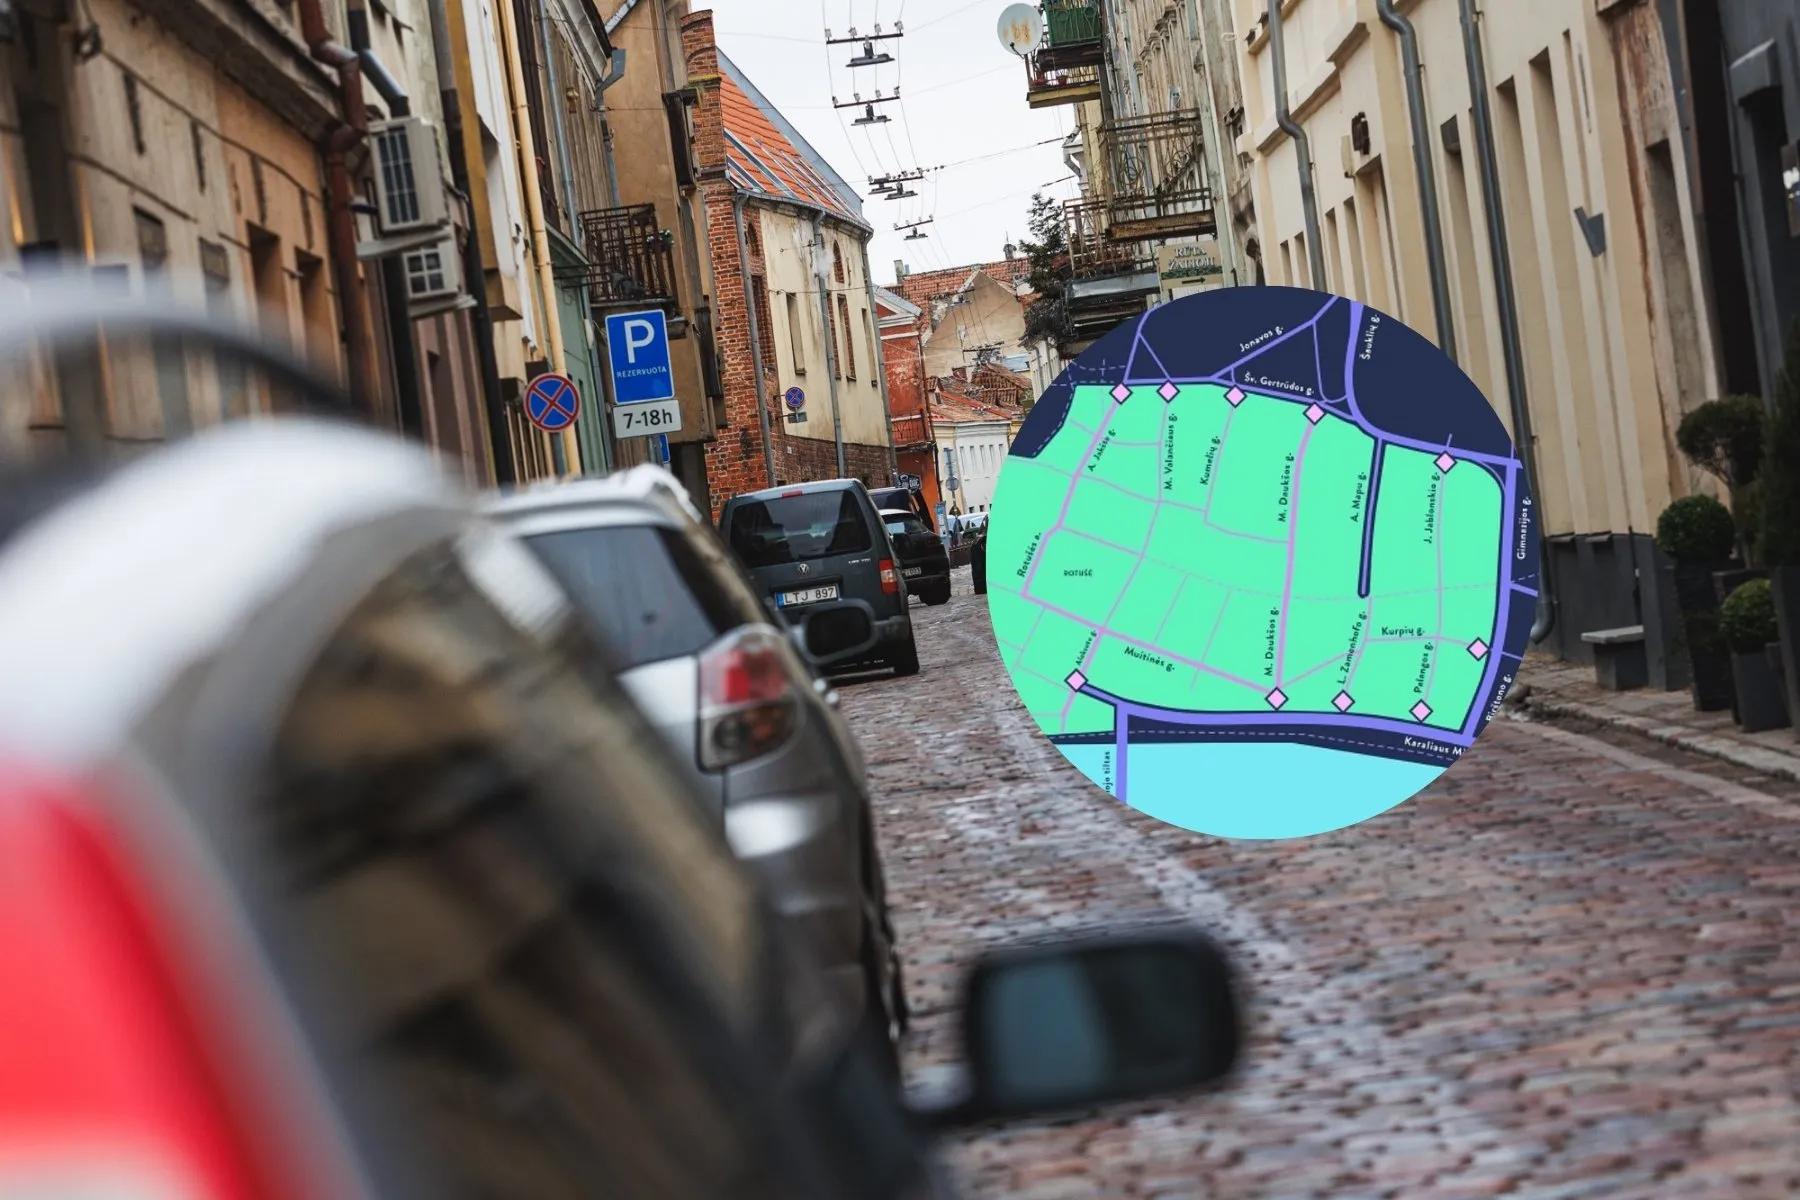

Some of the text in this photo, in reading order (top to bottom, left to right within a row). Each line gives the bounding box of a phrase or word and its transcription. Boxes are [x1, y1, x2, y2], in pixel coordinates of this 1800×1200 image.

[624, 319, 655, 364] P
[616, 366, 667, 379] REZERVUOTA
[623, 408, 672, 429] 7-18h
[784, 587, 835, 605] LTJ 897
